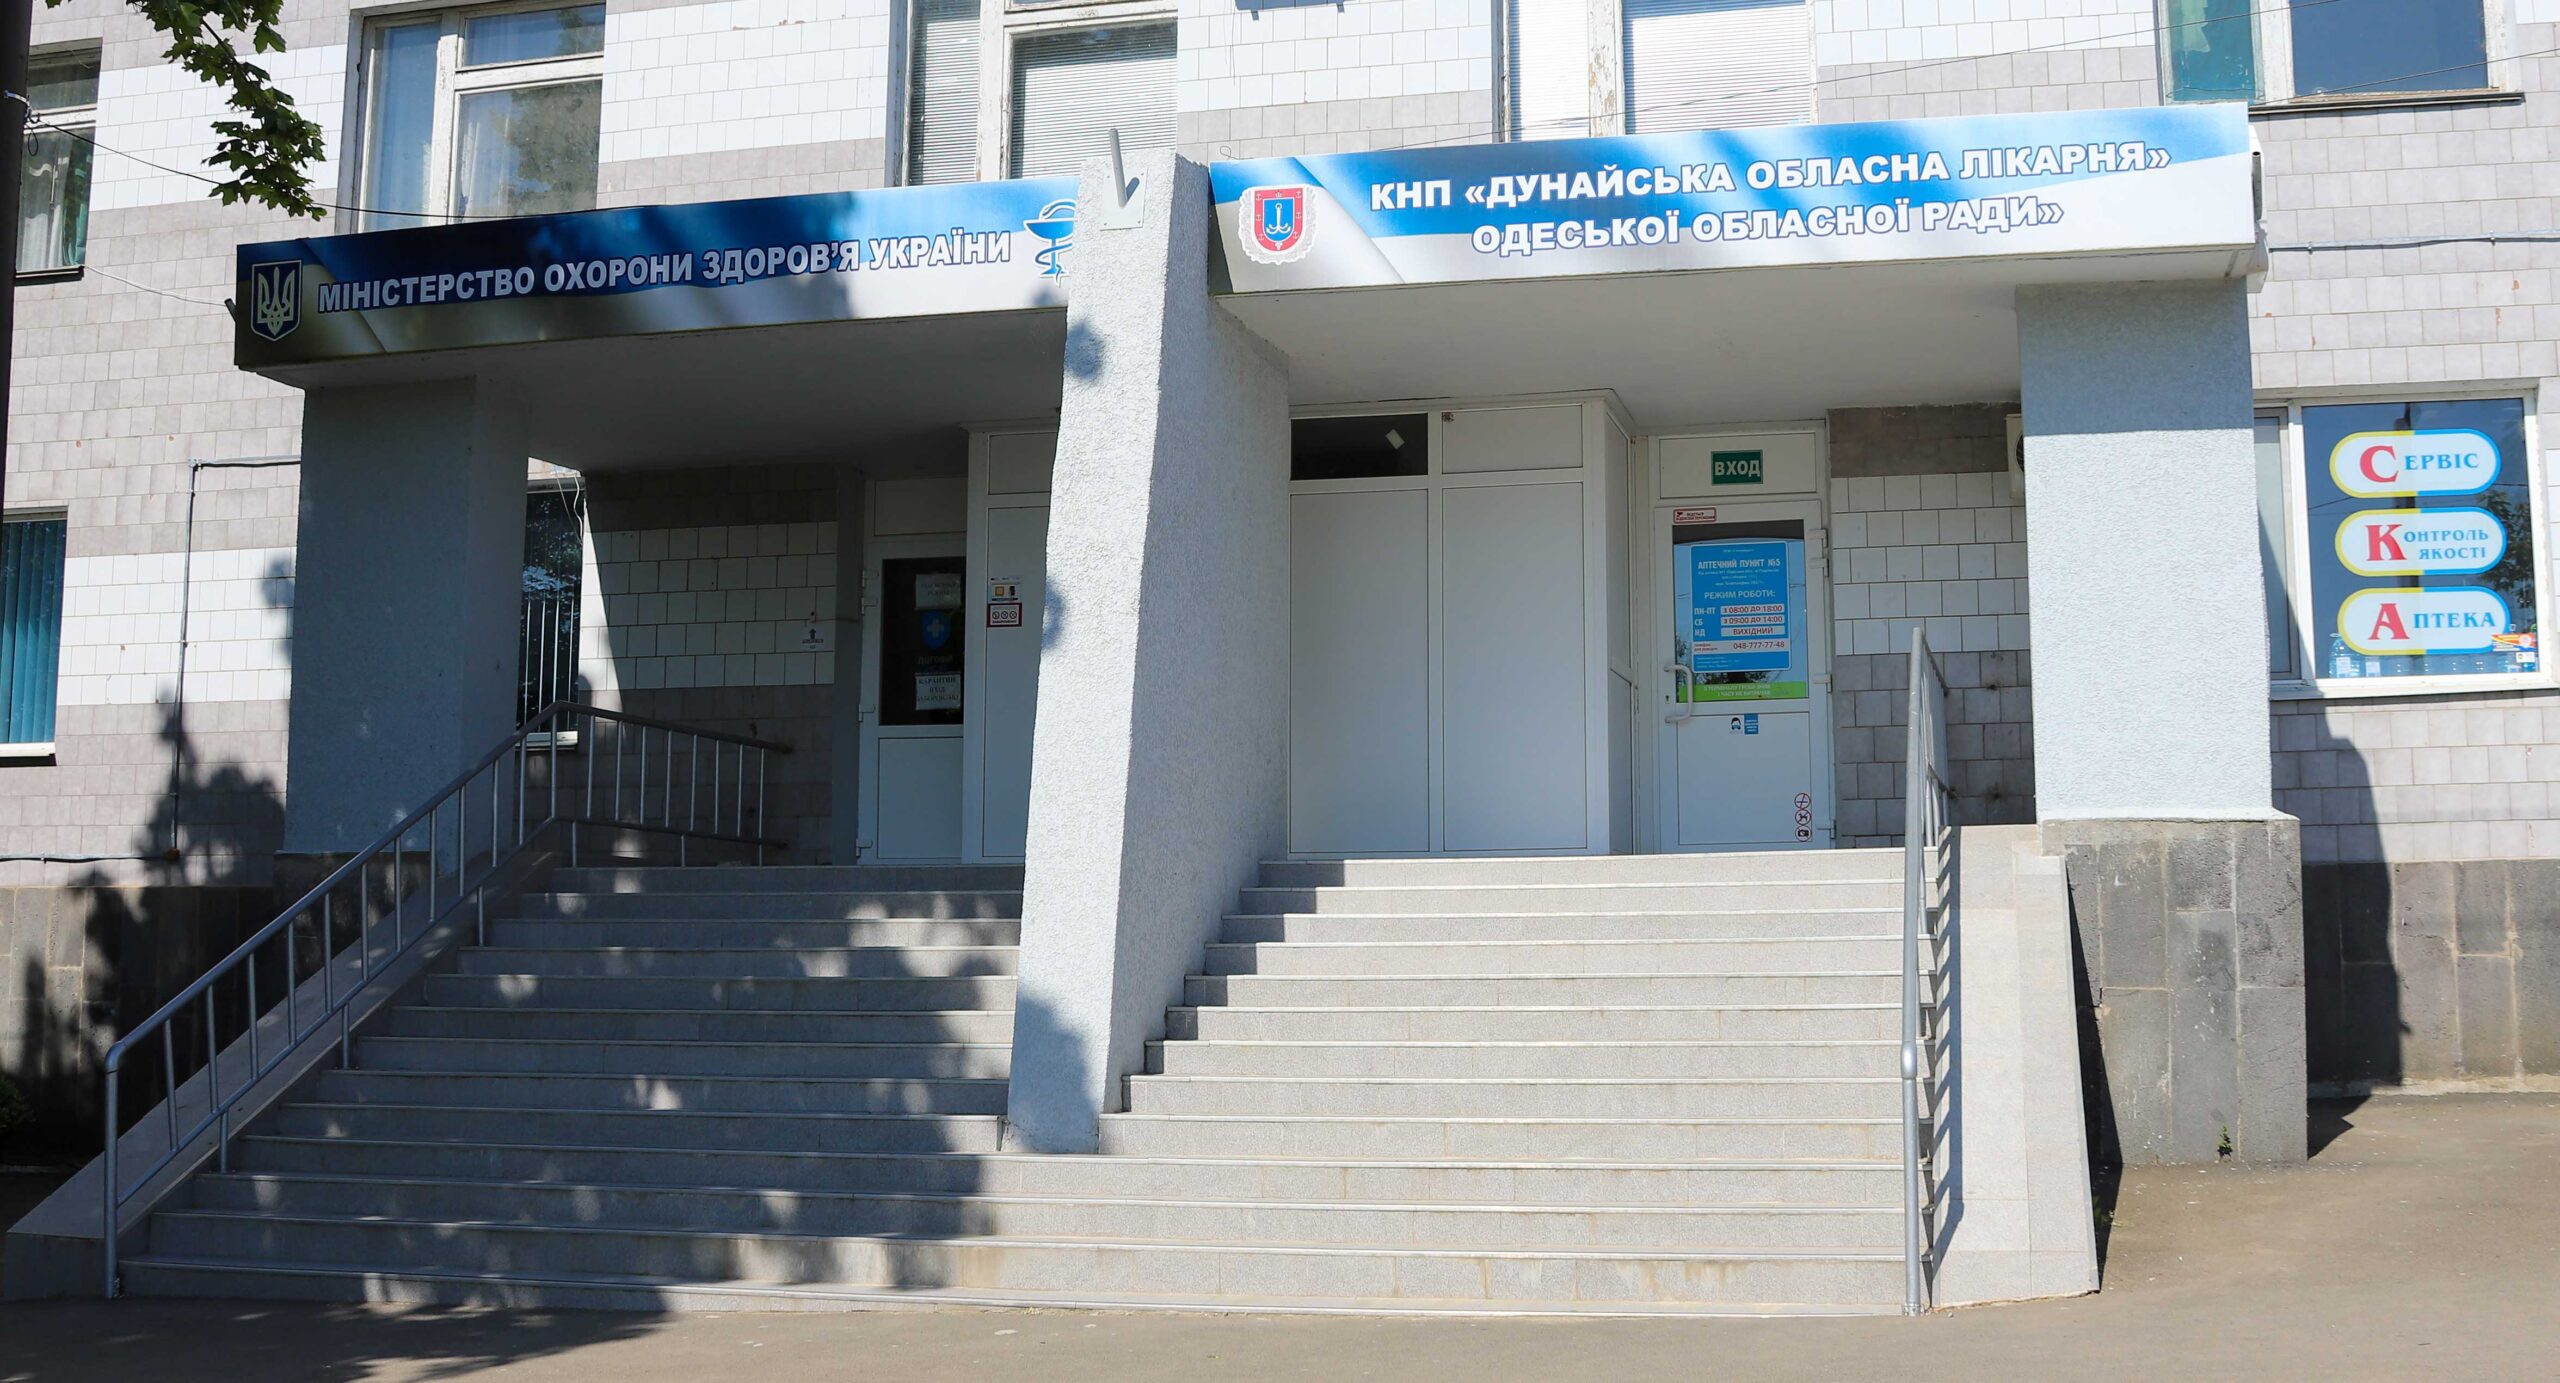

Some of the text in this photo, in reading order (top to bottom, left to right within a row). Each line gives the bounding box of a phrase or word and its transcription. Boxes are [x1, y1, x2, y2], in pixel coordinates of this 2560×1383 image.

[1371, 141, 2172, 211] КНП «ДУНАЙСЬКА ОБЛАСНА ЛІКАРНЯ»
[1471, 195, 2065, 257] ОДЕСЬКОЇ ОБЛАСНОЇ РАДИ»
[318, 265, 535, 314] МІНІСТЕРСТВО
[544, 254, 693, 293] ОХОРОНИ
[869, 228, 1012, 270] УКРАЇНИ
[1714, 460, 1761, 477] ВХОД
[2419, 547, 2486, 560] ЯКОСТІ
[1698, 559, 1737, 569] АПТЕЧНИЙ
[1740, 558, 1764, 568] ПУНКТ
[1704, 589, 1776, 600] РЕЖИМ РОБОТИ:
[1728, 617, 1749, 625] 09:00
[1733, 626, 1774, 636] ВИХІДНИЙ
[1733, 641, 1785, 650] 048-777-77-48
